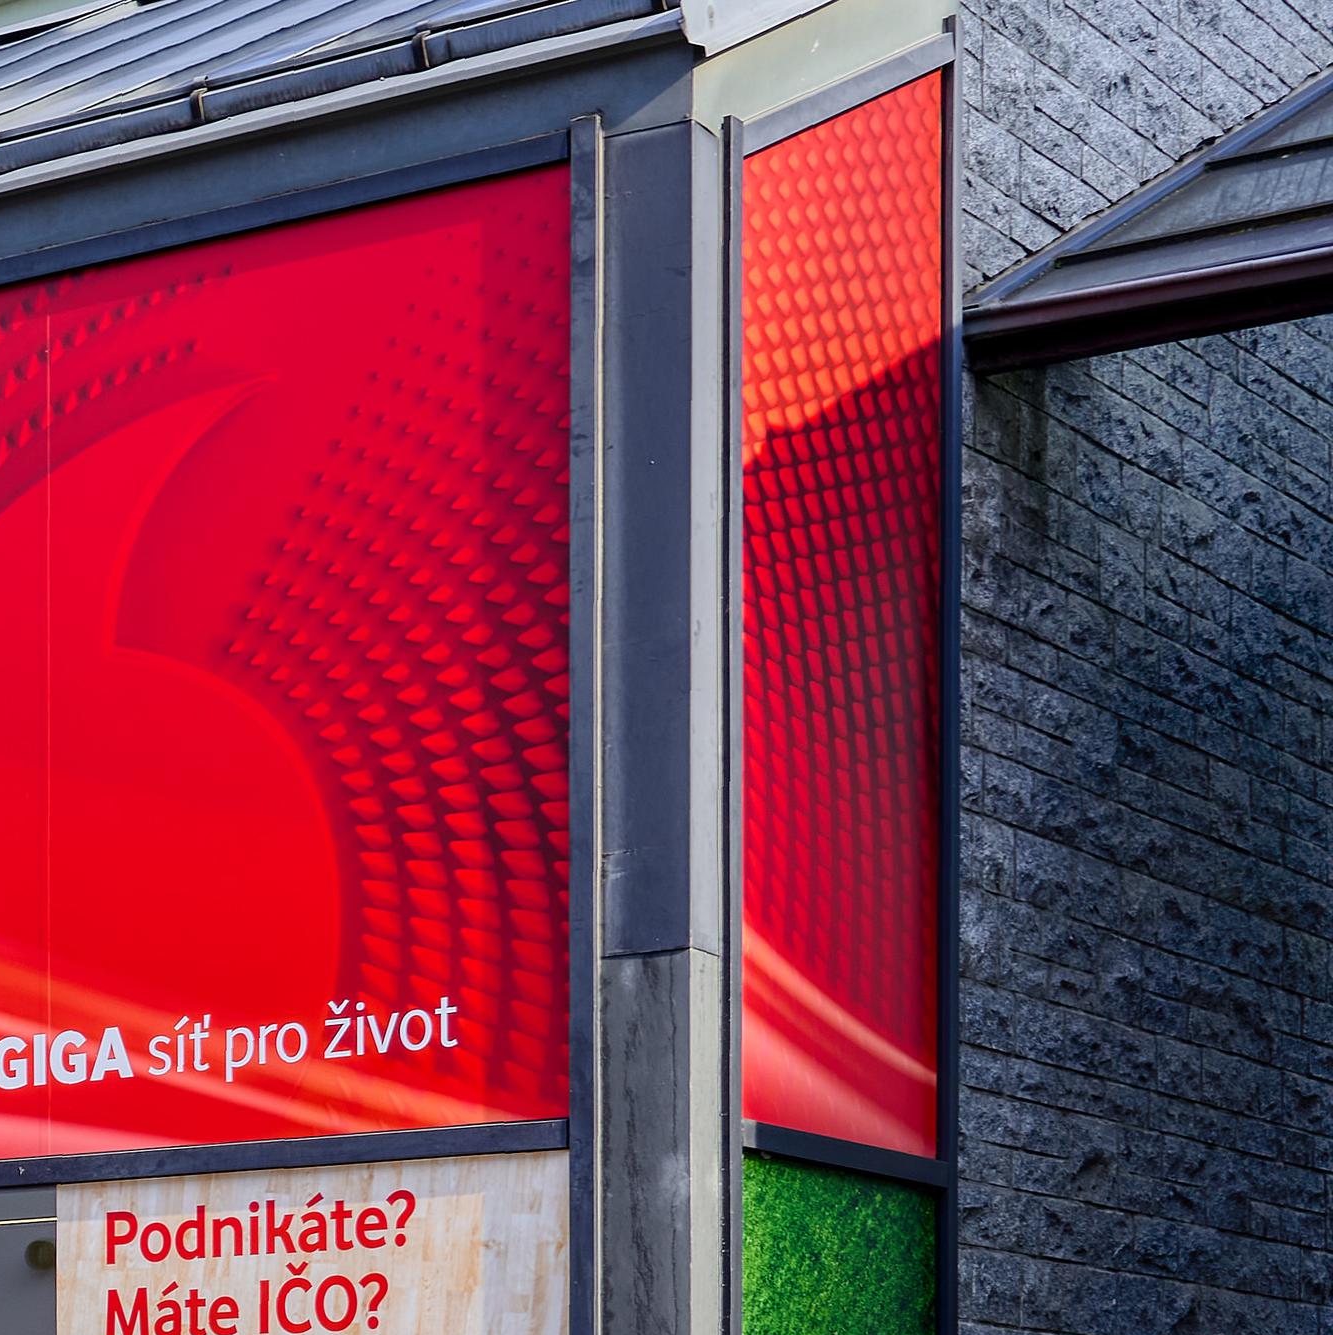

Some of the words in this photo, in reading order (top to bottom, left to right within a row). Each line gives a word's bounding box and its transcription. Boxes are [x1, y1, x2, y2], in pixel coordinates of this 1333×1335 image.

[148, 1014, 211, 1076] síť
[225, 1021, 308, 1083] pro
[323, 996, 458, 1060] život
[105, 1189, 416, 1266] Podnikáte?
[258, 1261, 389, 1335] IČO?
